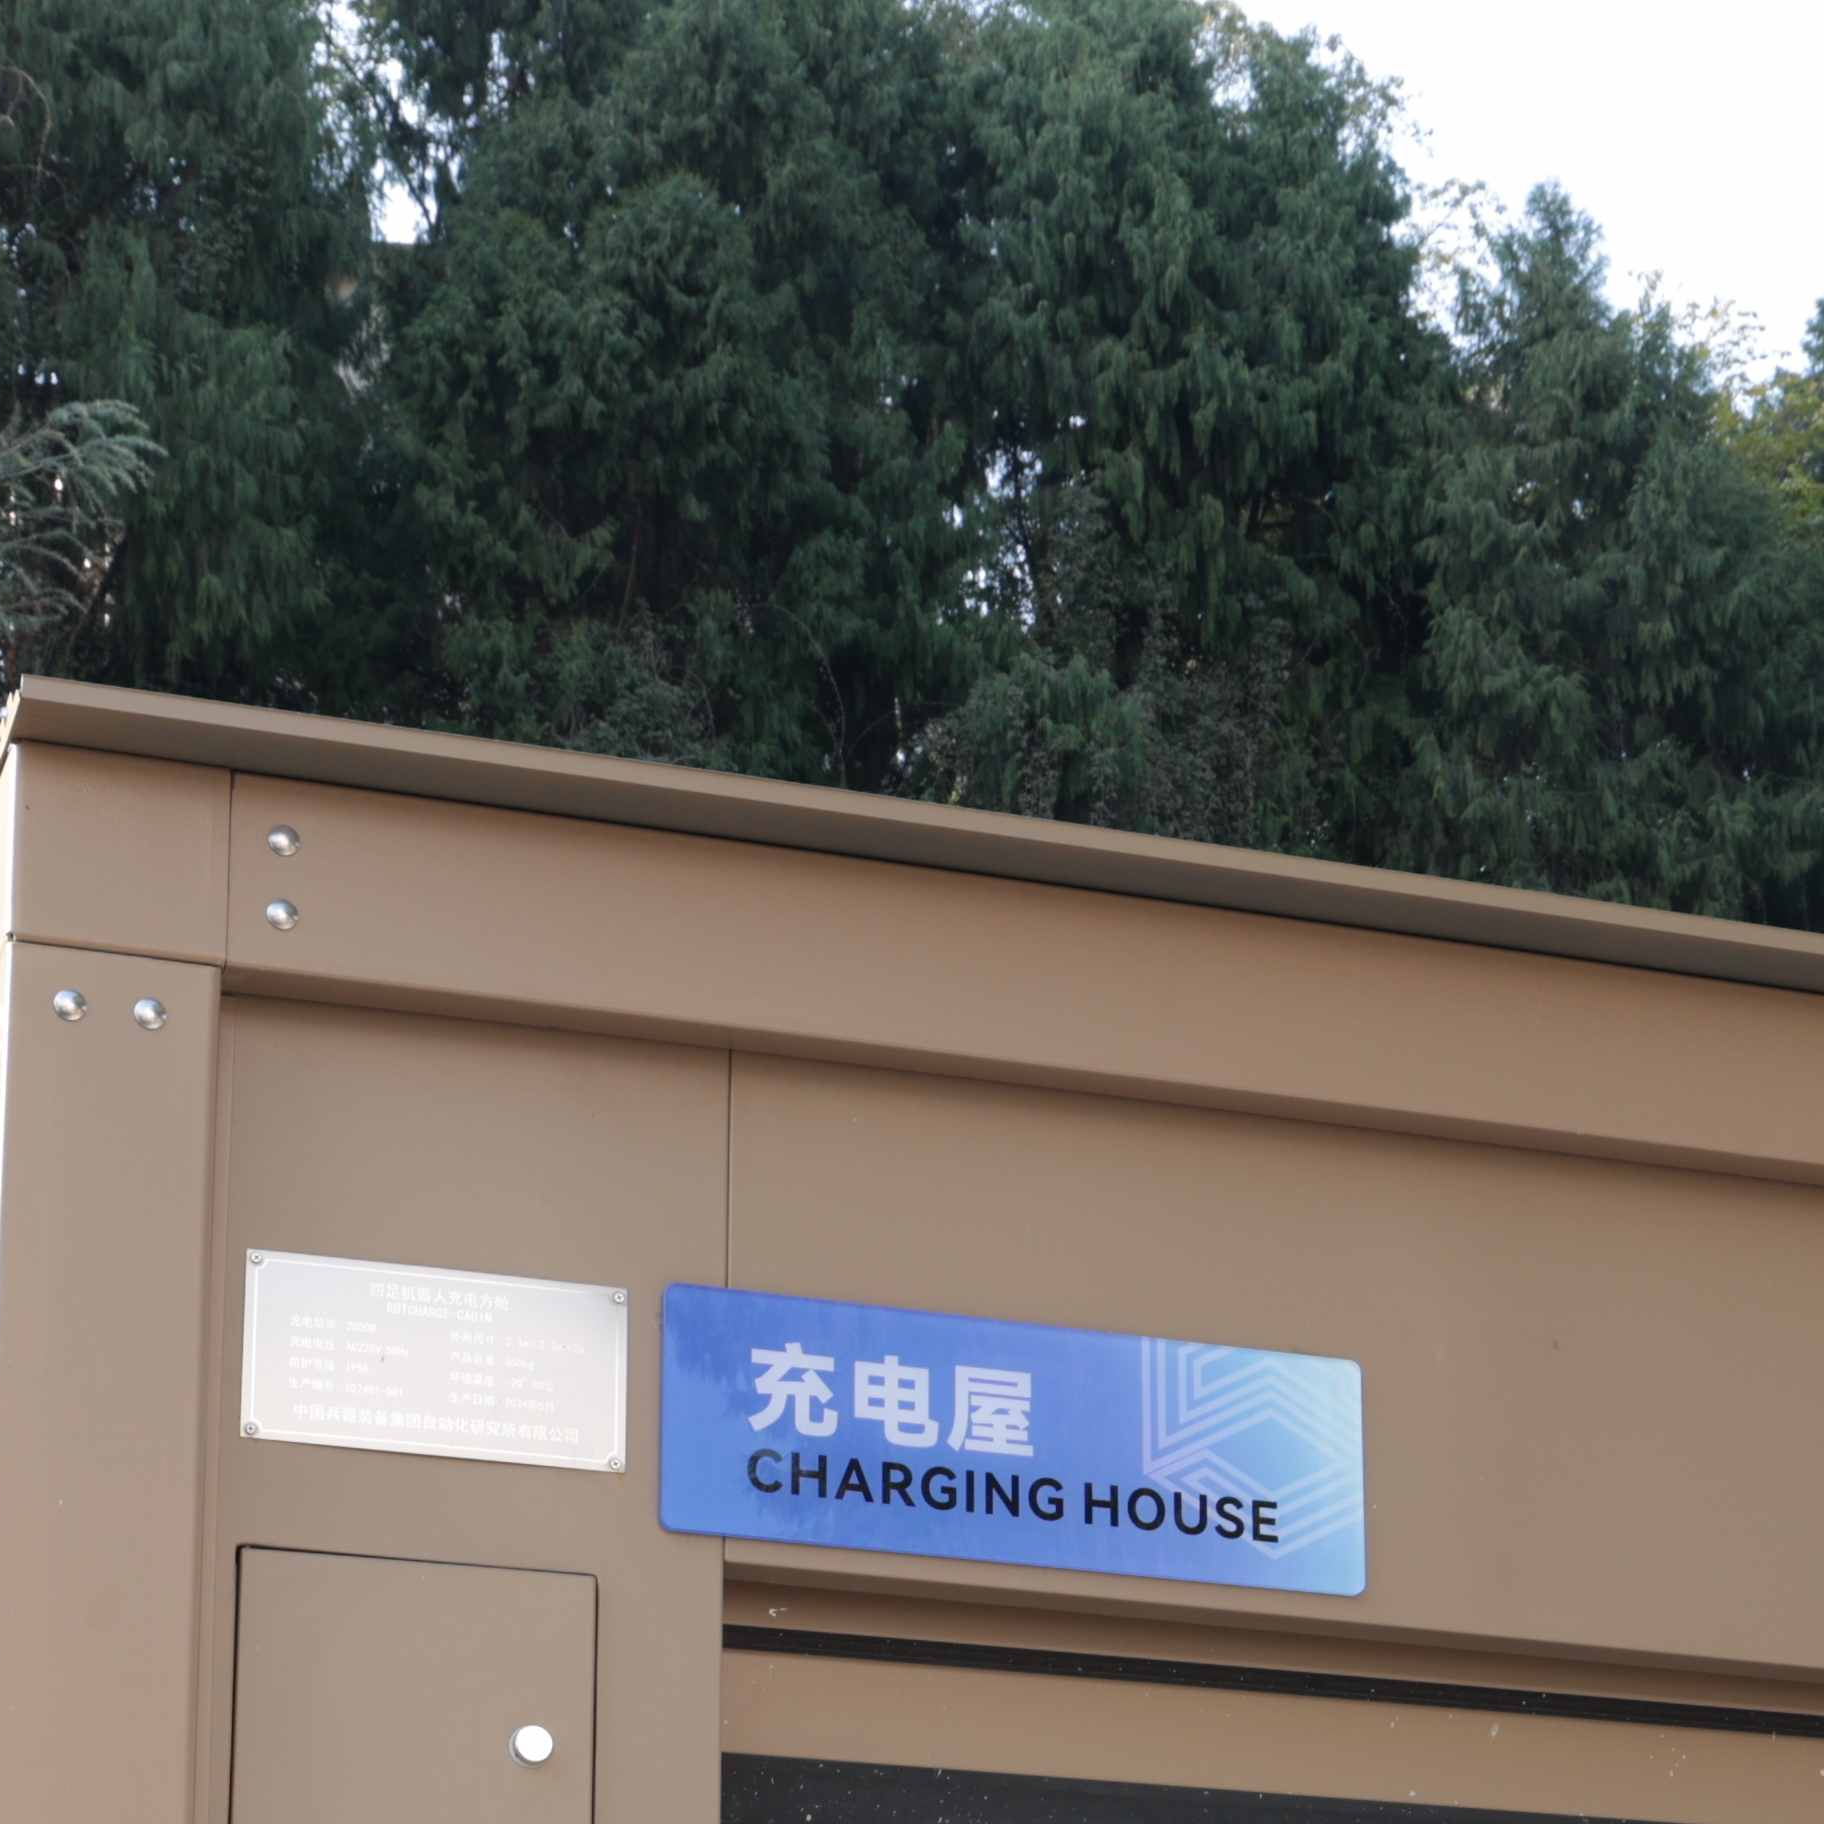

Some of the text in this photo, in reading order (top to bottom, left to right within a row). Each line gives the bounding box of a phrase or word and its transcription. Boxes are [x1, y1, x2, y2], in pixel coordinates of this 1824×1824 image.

[746, 1341, 1035, 1458] 充电屋
[746, 1447, 1280, 1543] CHARGING HOUSE
